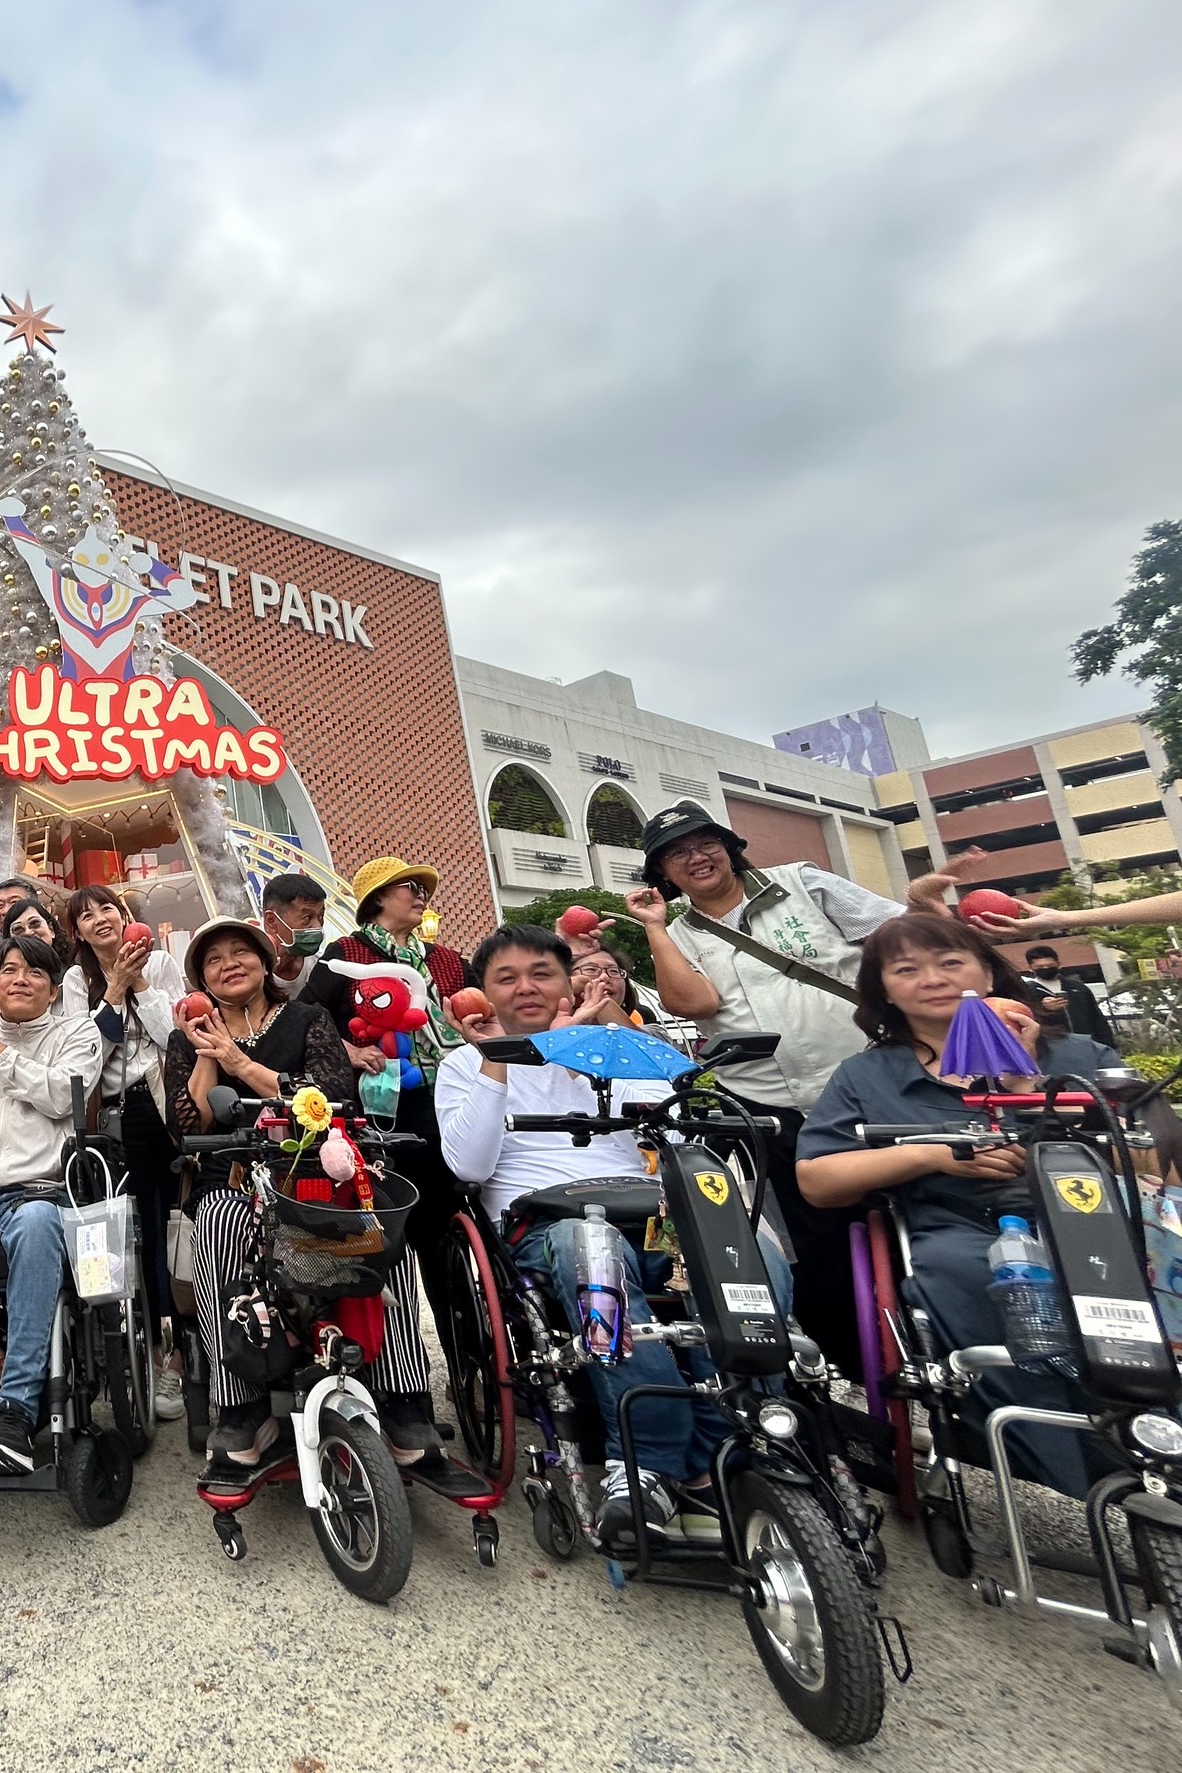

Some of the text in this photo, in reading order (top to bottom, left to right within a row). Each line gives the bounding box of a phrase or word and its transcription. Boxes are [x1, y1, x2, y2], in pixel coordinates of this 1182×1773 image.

[250, 572, 374, 649] PARK
[14, 666, 209, 727] ULTRA
[773, 928, 798, 958] 身福
[784, 915, 818, 959] 社會局
